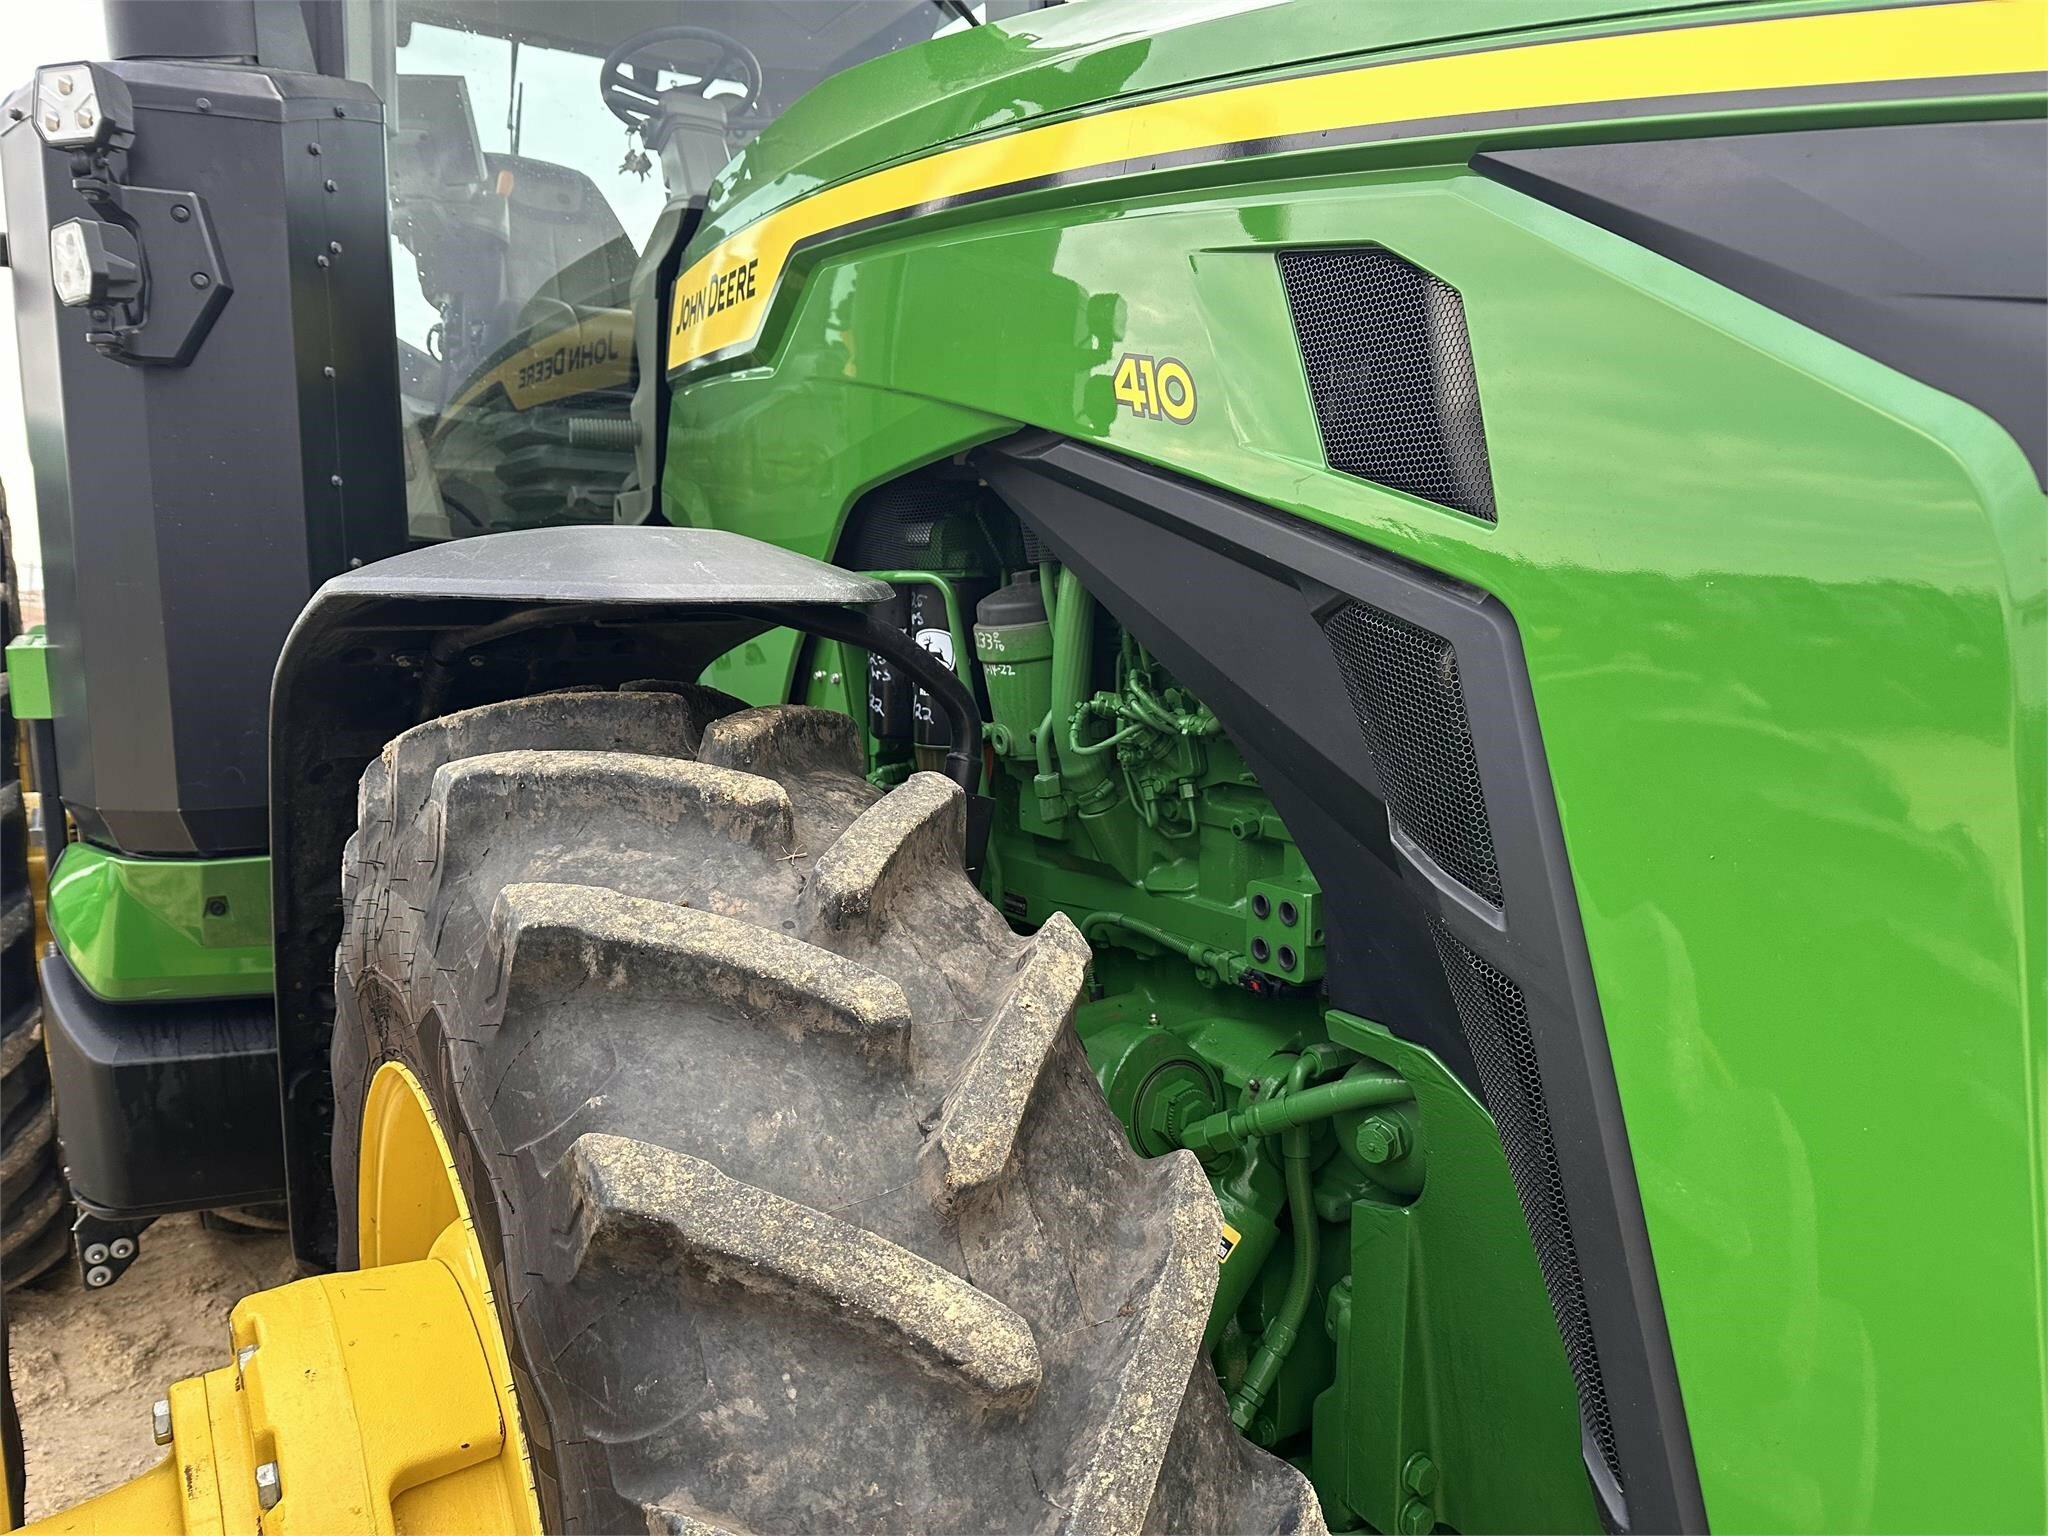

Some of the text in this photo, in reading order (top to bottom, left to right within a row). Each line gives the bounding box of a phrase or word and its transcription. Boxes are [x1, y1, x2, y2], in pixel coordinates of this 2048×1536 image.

[676, 258, 758, 335] JOHN DEERE
[1113, 352, 1197, 425] 410
